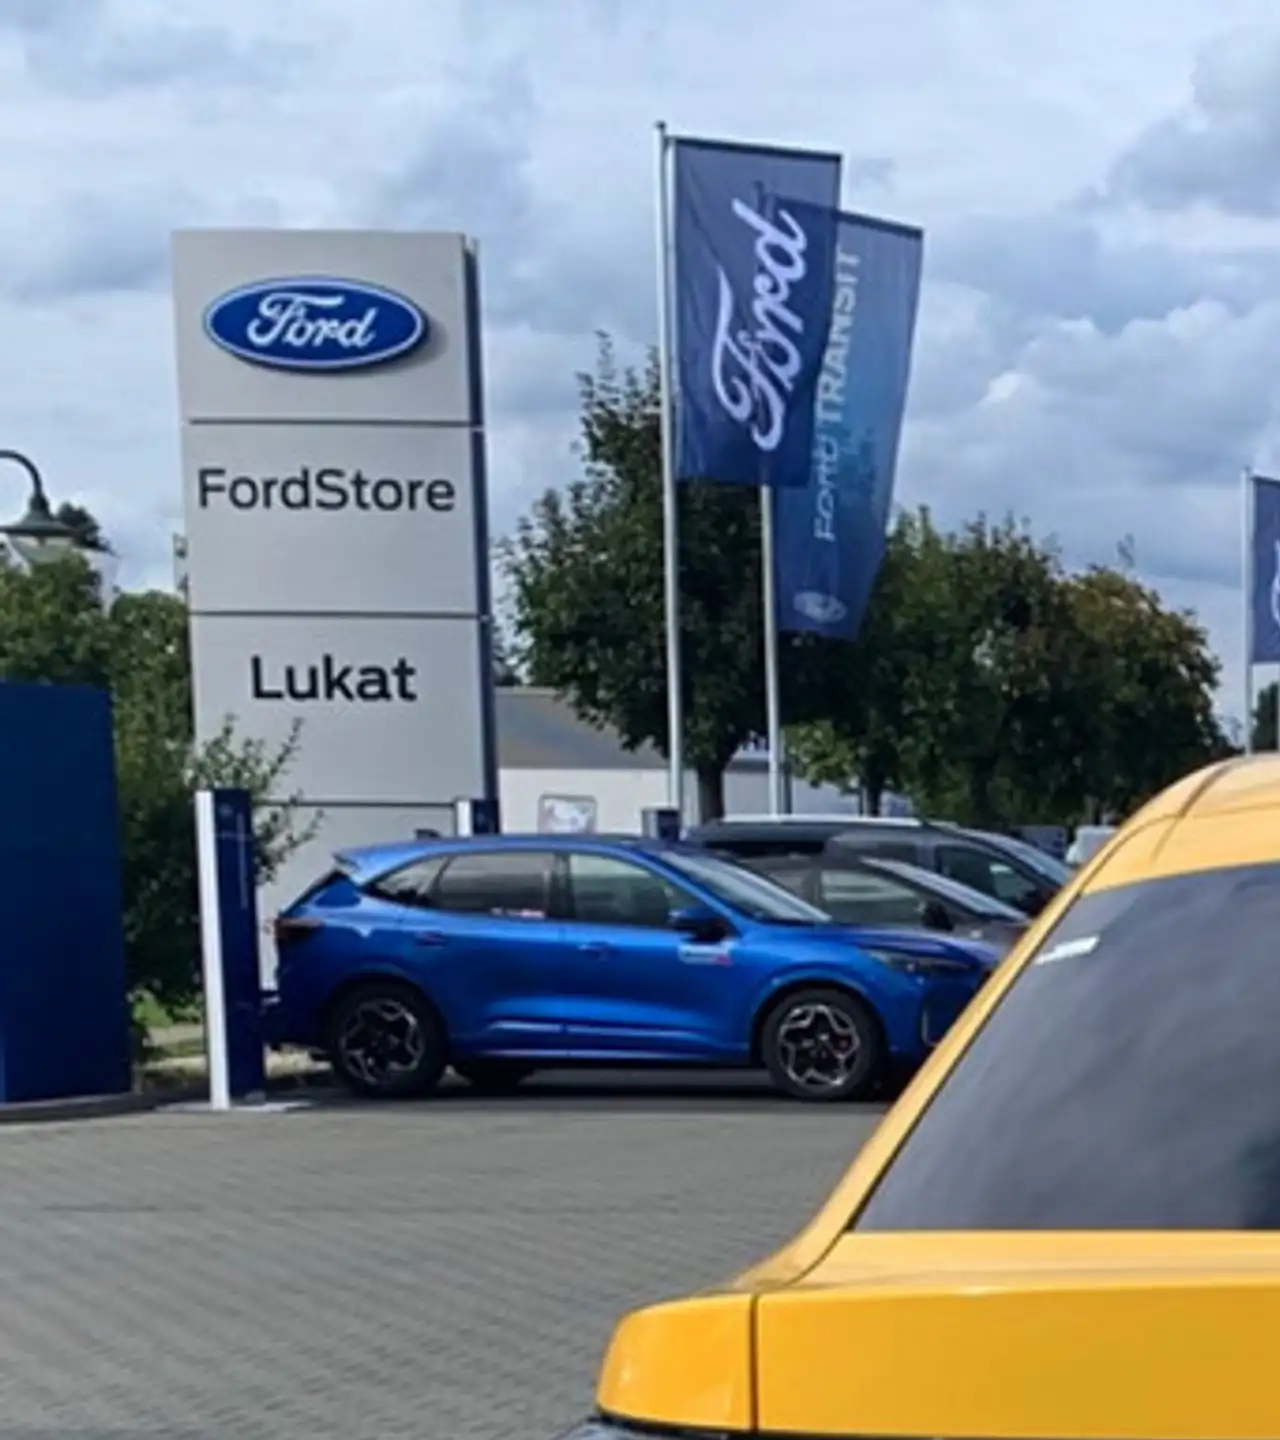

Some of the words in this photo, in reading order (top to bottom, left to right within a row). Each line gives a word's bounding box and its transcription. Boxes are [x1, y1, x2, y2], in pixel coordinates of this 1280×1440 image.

[246, 292, 378, 348] Ford
[711, 198, 807, 451] Ford
[815, 248, 861, 422] TRANSIT
[198, 467, 456, 511] FordStore
[250, 655, 418, 702] Lukat
